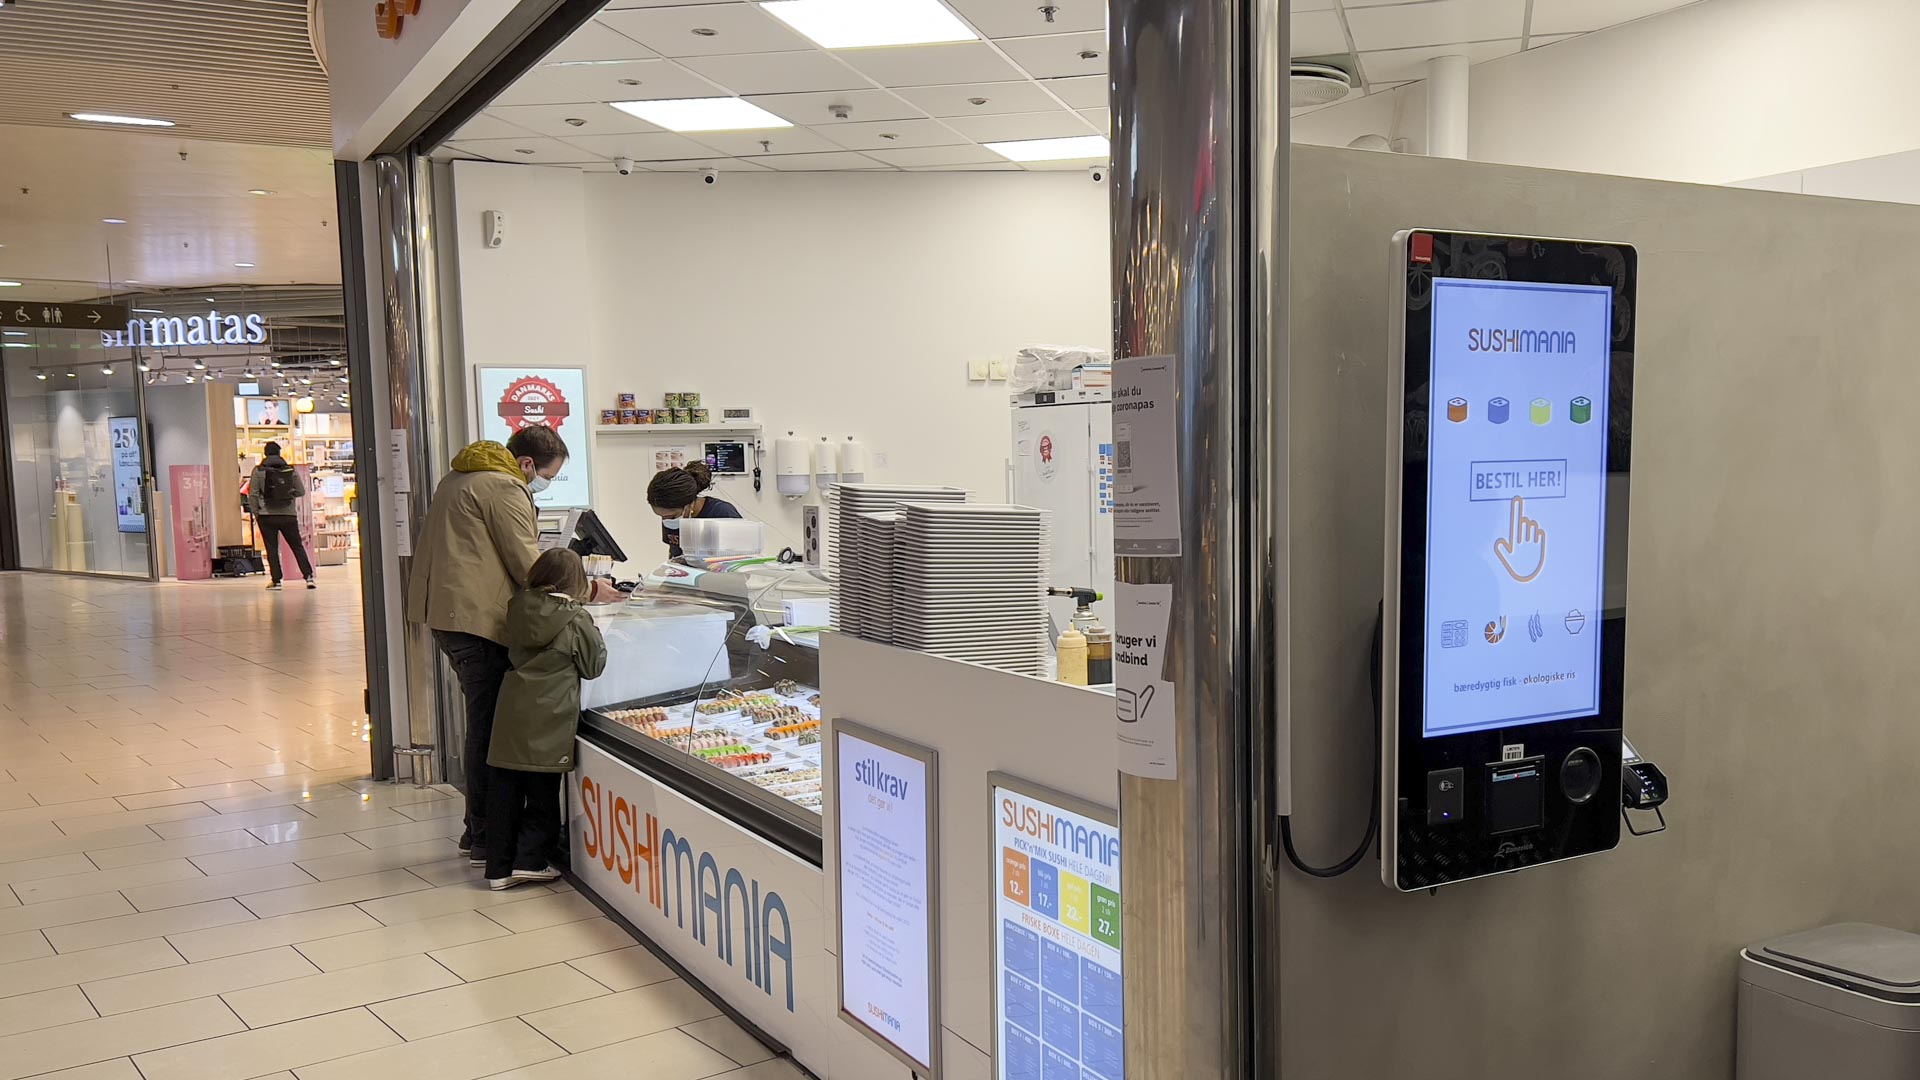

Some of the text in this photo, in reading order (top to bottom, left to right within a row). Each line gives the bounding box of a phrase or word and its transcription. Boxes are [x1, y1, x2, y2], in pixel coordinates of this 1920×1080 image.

[149, 310, 267, 345] matas
[1468, 328, 1576, 353] SUSHIMANIA
[511, 384, 556, 402] DANMARKS
[1118, 387, 1130, 398] skal
[1131, 386, 1142, 396] du
[524, 405, 545, 414] Sushi
[1117, 400, 1155, 412] coronapas
[1476, 471, 1561, 489] BESTIL HER!
[1145, 635, 1157, 648] vi
[1453, 670, 1576, 693] bæredygtig fisk økologiske ris
[581, 776, 794, 1013] SUSHIMANIA
[1022, 912, 1041, 931] FRISKE
[1043, 922, 1060, 940] BOXE
[1098, 918, 1115, 937] 27.-
